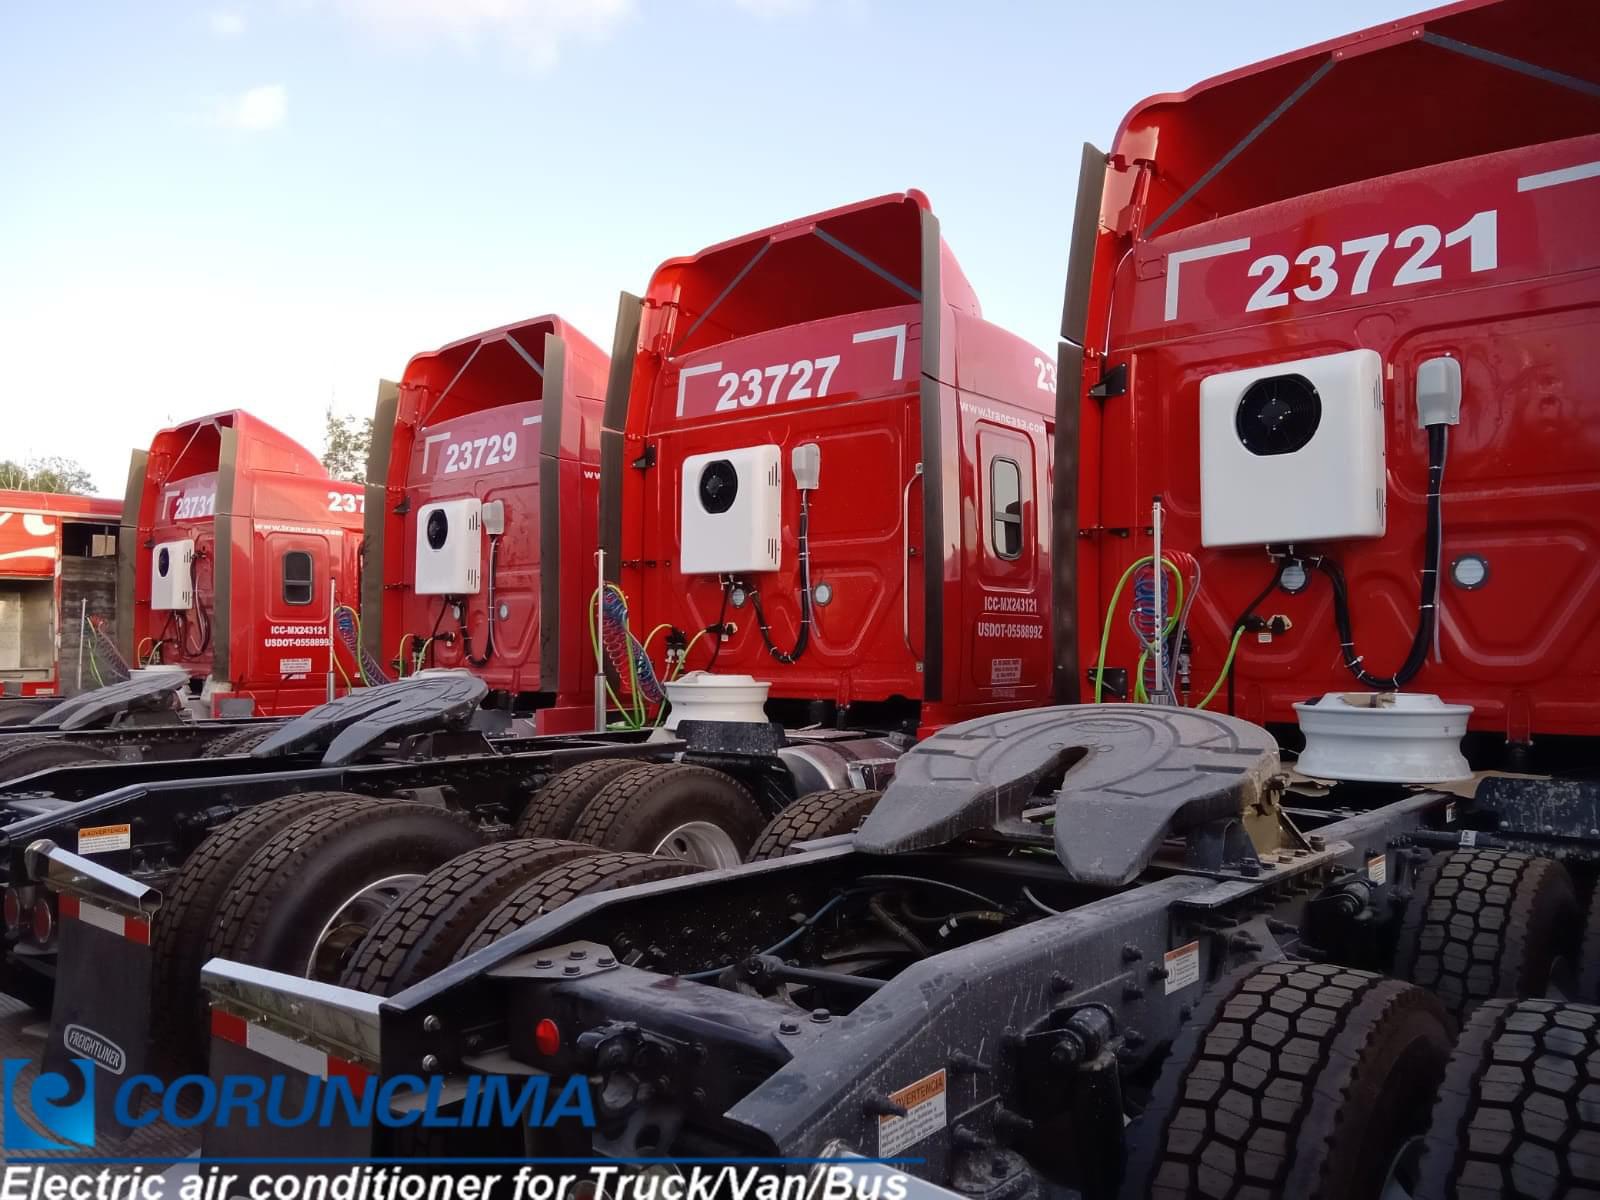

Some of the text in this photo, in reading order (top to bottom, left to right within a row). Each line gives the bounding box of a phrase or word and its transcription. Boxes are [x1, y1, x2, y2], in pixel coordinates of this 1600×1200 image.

[1245, 209, 1498, 313] 23721
[715, 354, 841, 412] 23727
[444, 431, 517, 474] 23729
[174, 493, 215, 520] 23731
[984, 596, 1038, 613] ICC-MX243121
[69, 1030, 120, 1068] FREIGHTLINER
